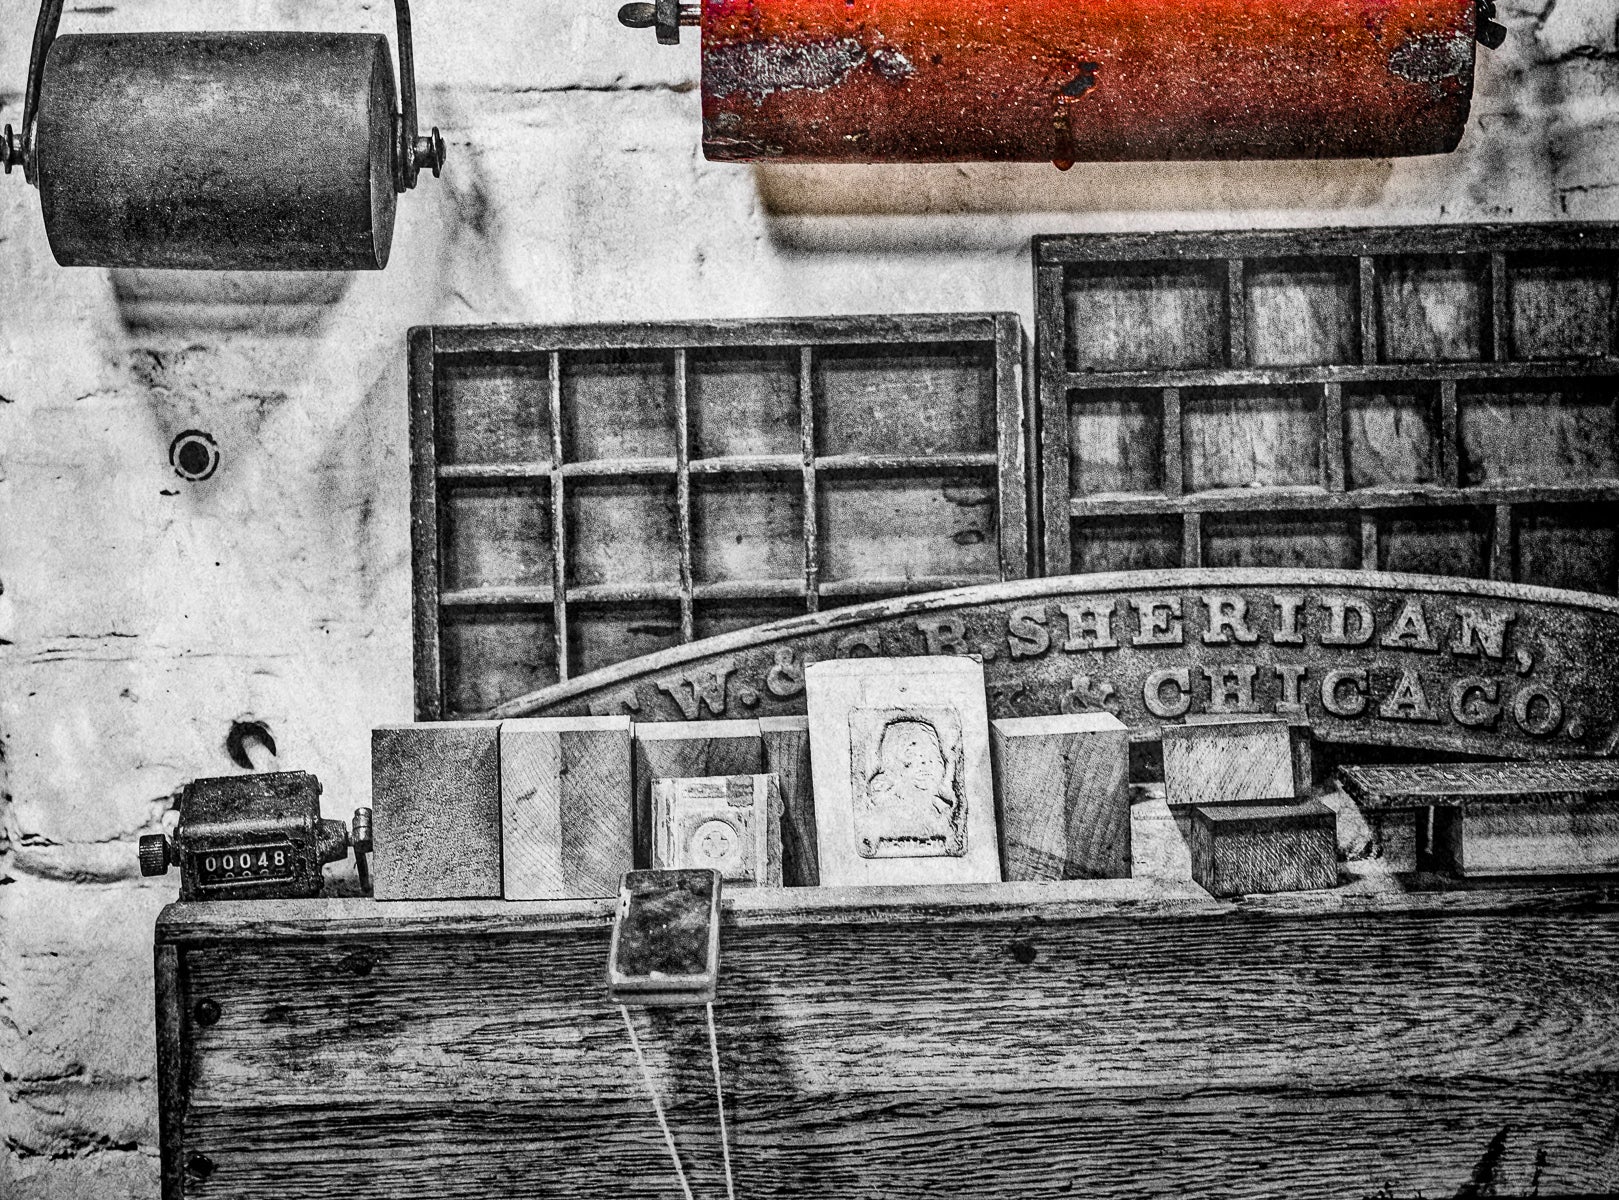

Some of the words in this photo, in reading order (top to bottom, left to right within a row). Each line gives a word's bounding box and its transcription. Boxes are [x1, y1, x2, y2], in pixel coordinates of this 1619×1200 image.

[1007, 596, 1532, 674] SHERIDAN,
[1144, 666, 1584, 739] CHICAGO.
[205, 851, 285, 872] 00048
